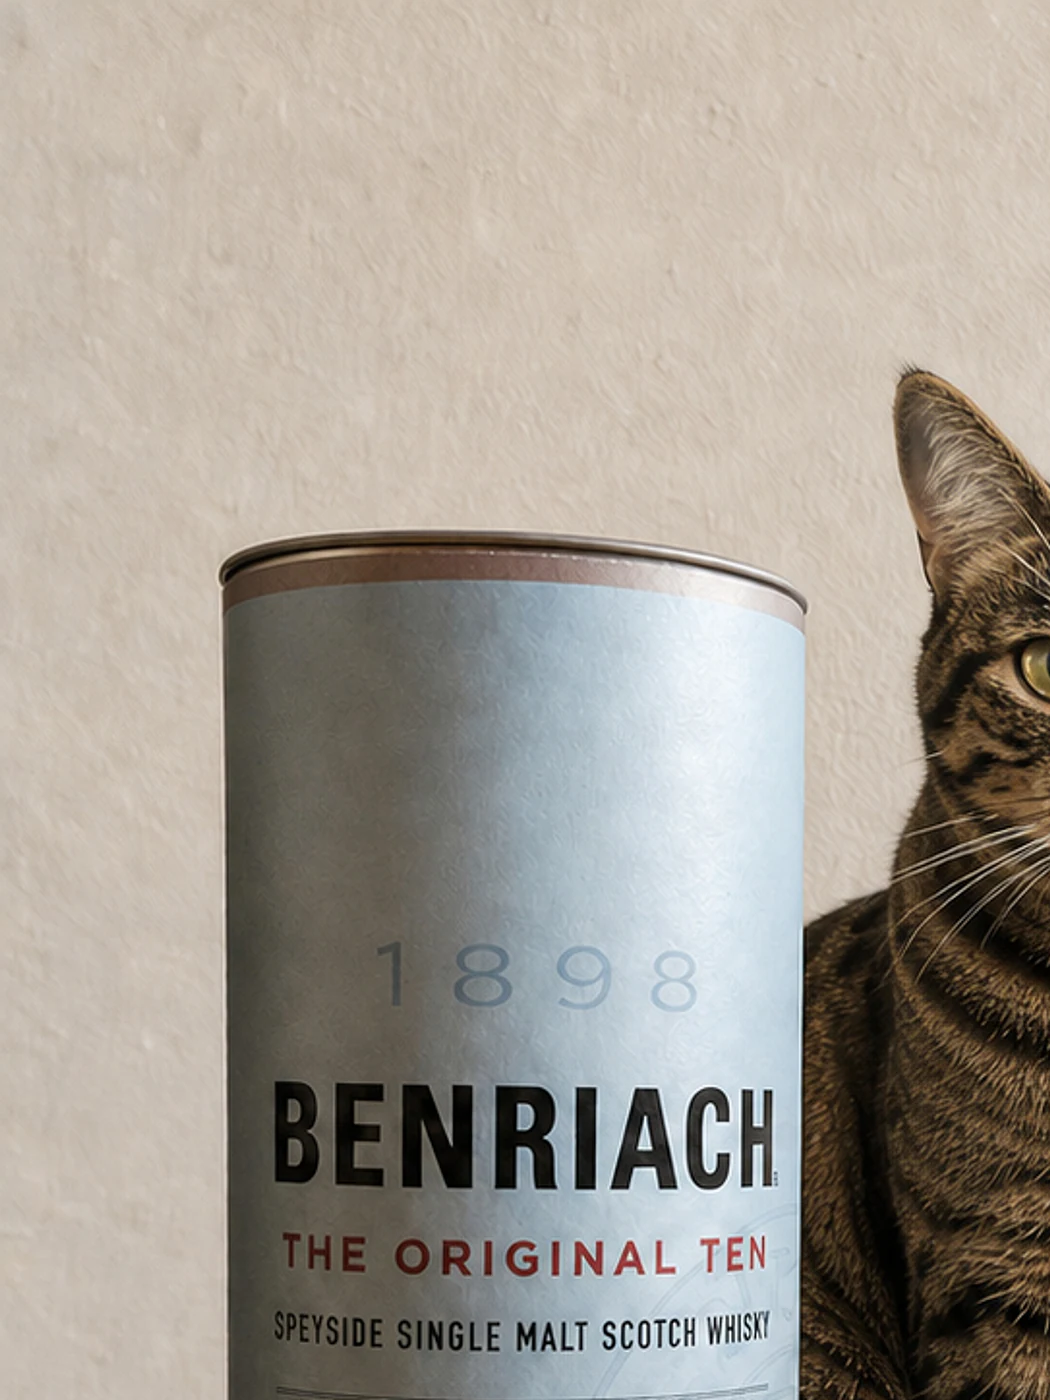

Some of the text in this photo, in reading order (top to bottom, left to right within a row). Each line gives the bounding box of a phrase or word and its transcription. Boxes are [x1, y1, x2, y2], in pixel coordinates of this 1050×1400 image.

[376, 941, 698, 1013] 1898
[274, 1081, 774, 1190] BENRIACH
[282, 1232, 766, 1278] THE ORIGINAL TEN
[274, 1310, 771, 1353] SPEYSIDE SINGLE MALT SCOTCH WHISKY
